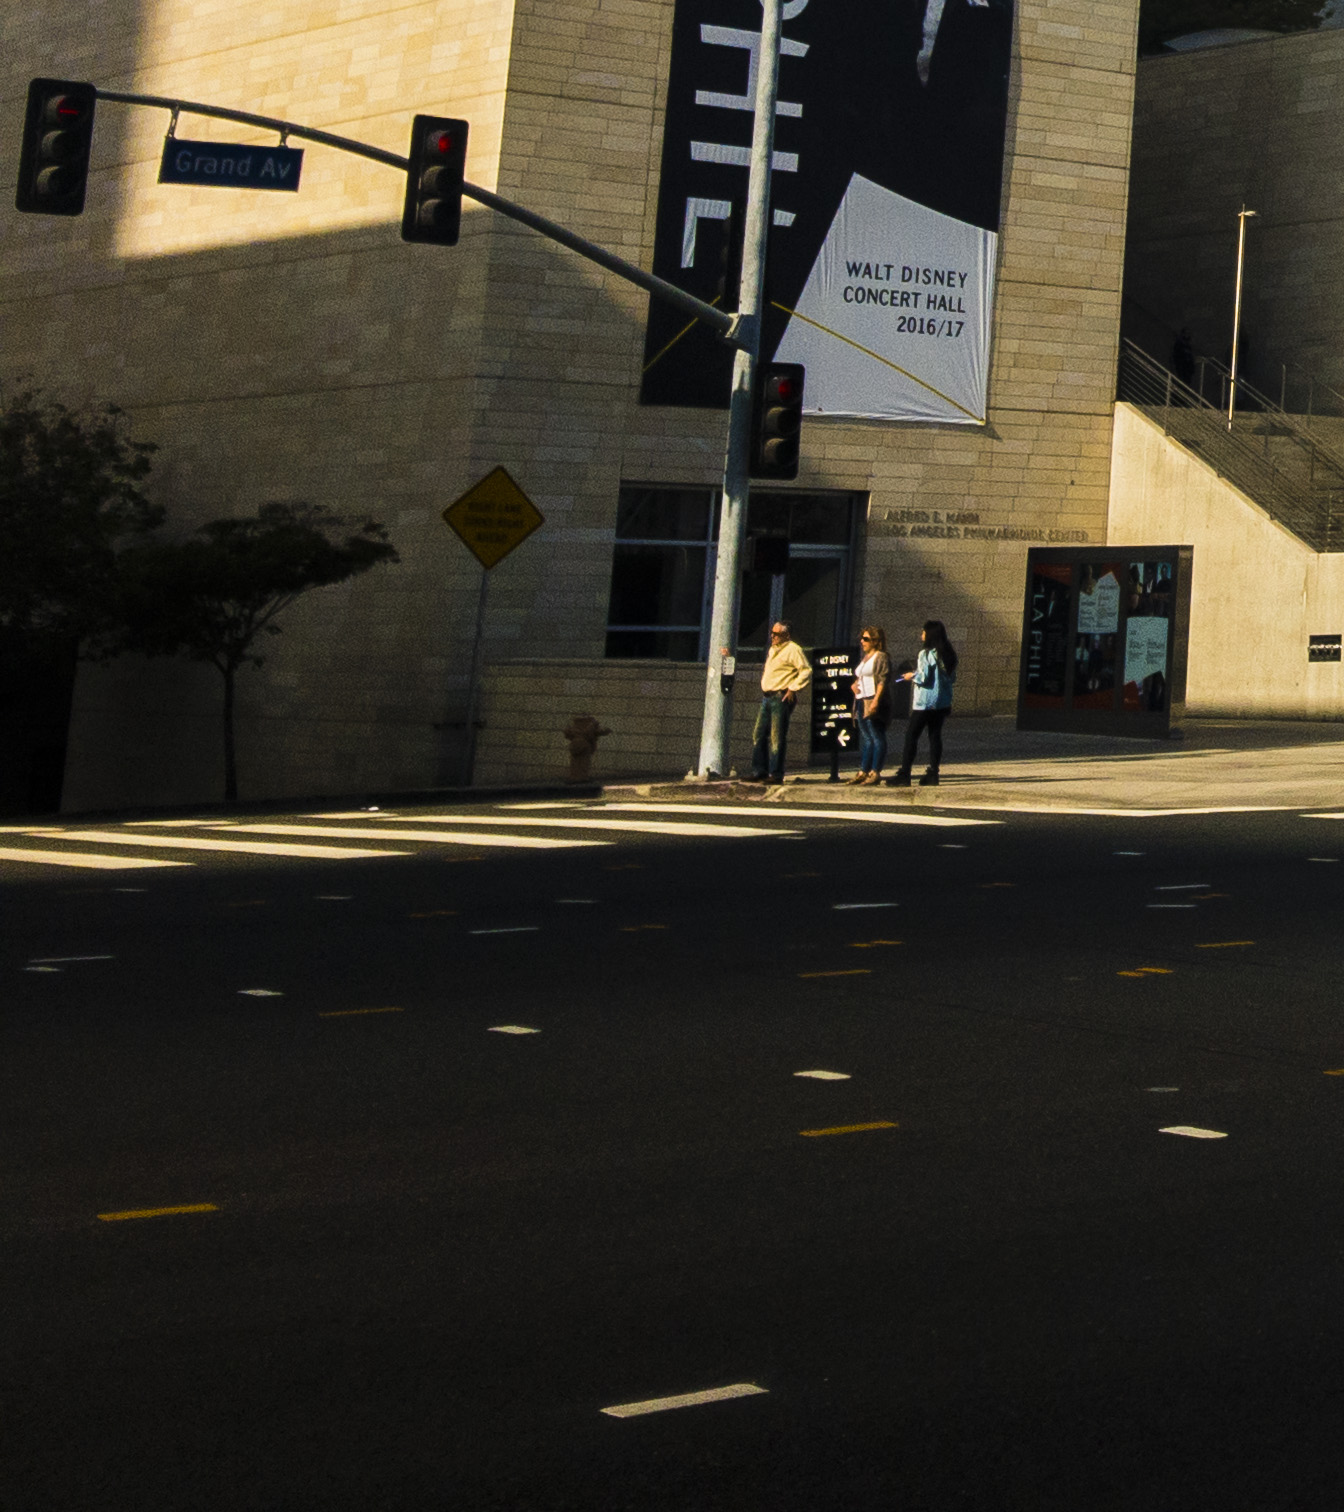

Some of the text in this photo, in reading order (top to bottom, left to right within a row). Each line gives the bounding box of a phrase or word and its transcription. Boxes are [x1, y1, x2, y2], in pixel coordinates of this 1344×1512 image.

[175, 149, 291, 180] Grand Av
[846, 260, 968, 289] WALT DISNEY
[843, 285, 966, 314] CONCERT HALL
[896, 315, 965, 338] 2016/17
[1027, 593, 1045, 684] LA PHIL
